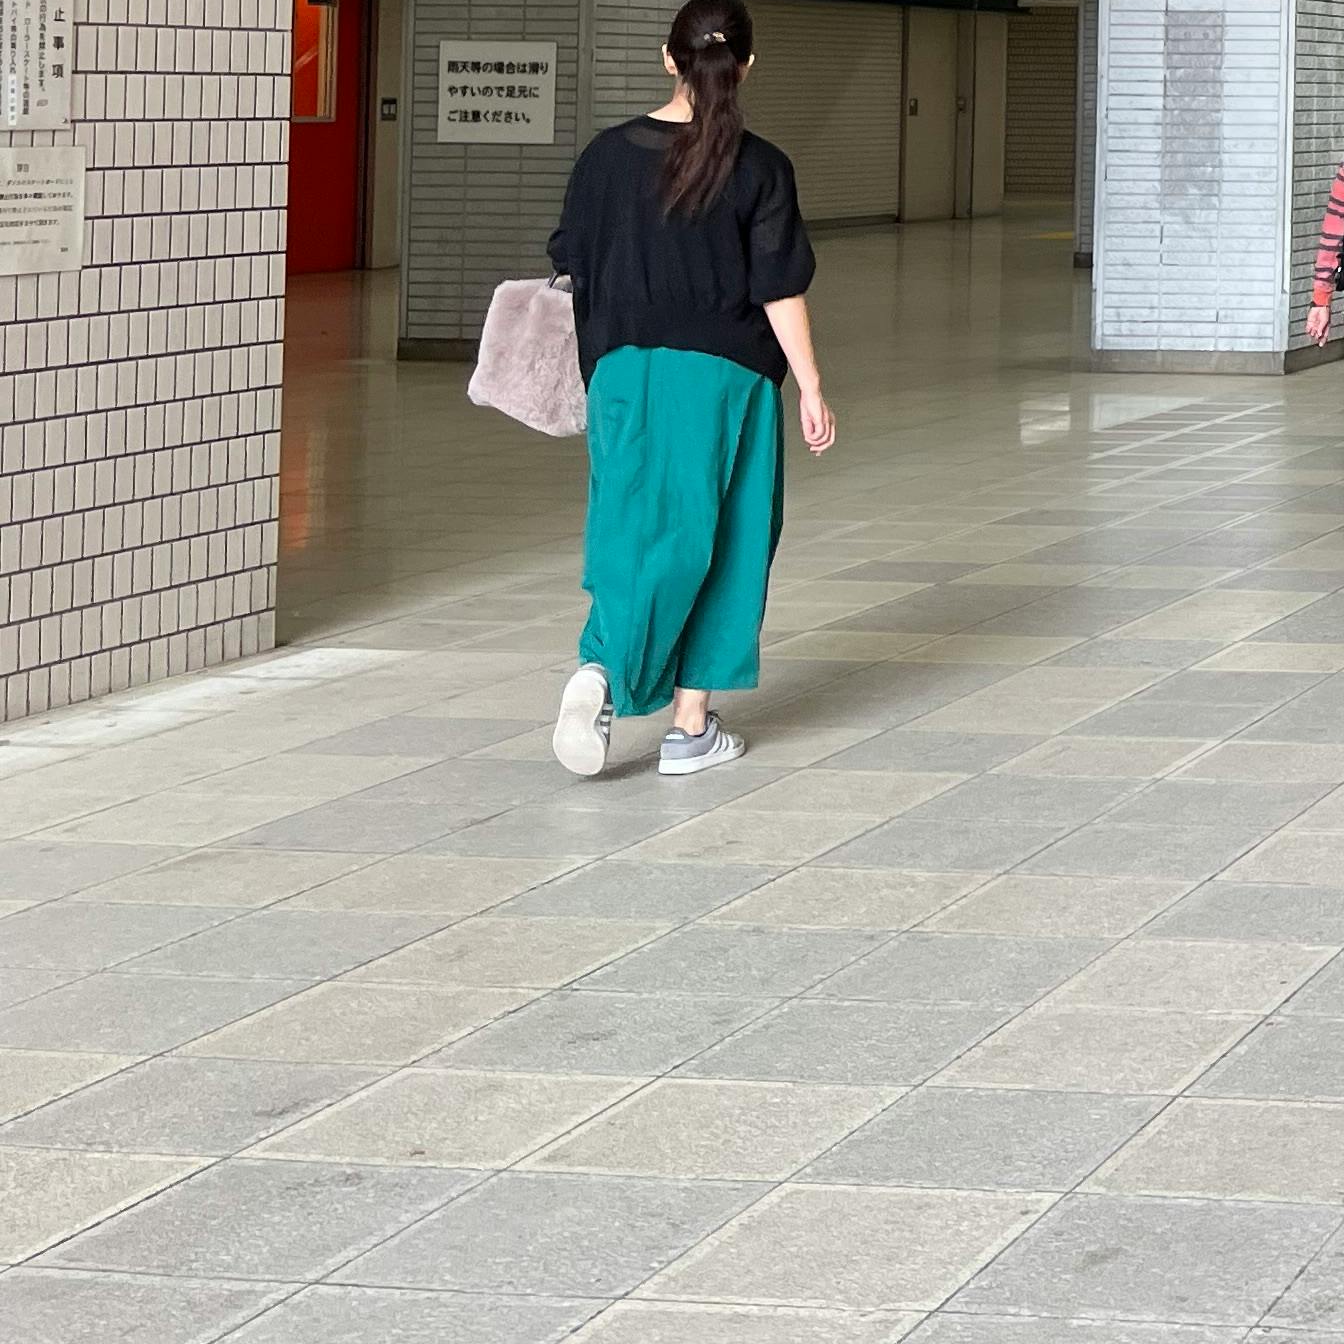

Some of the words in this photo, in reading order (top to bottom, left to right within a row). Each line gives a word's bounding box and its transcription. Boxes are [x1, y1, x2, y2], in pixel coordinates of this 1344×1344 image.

[447, 60, 549, 74] 雨天等の場合は滑り
[447, 85, 540, 98] やすいので足元に
[447, 110, 531, 123] ご注意ください。
